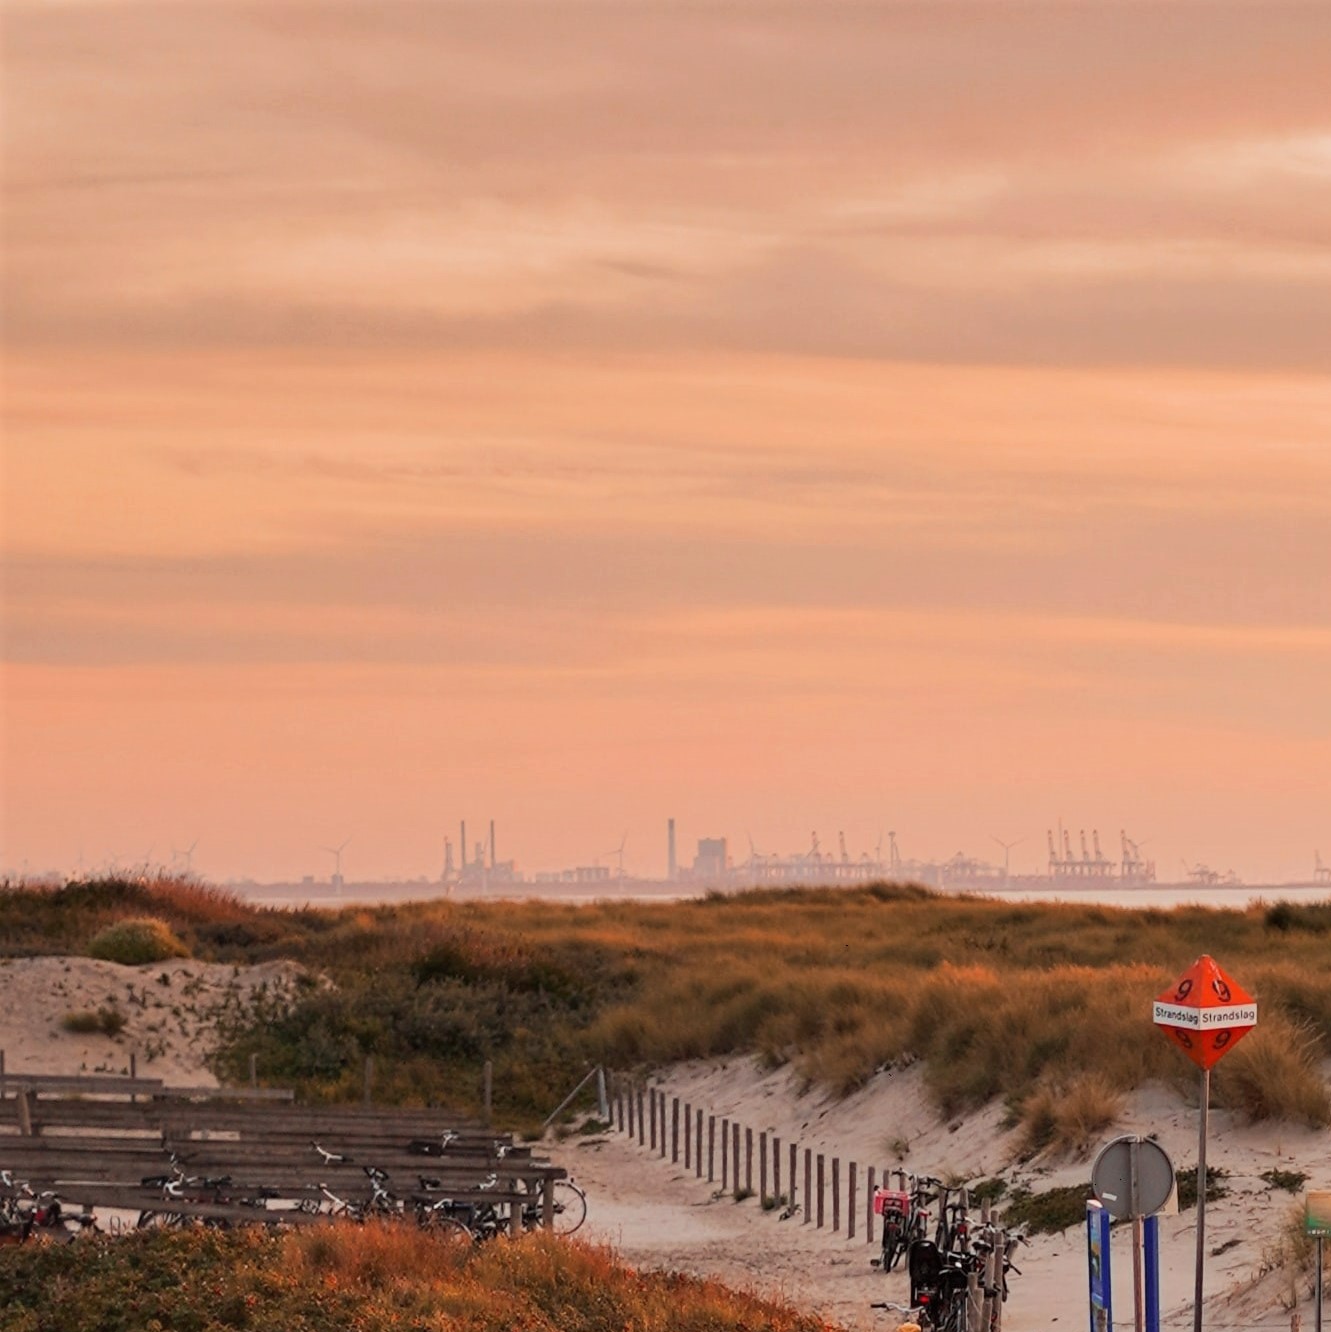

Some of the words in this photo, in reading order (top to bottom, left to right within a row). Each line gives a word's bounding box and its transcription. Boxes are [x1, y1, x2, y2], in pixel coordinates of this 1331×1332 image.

[1174, 979, 1193, 1002] 9
[1212, 979, 1231, 1002] 9
[1155, 1007, 1199, 1025] Strandslag
[1202, 1010, 1255, 1024] Strandslag
[1213, 1030, 1231, 1050] 9
